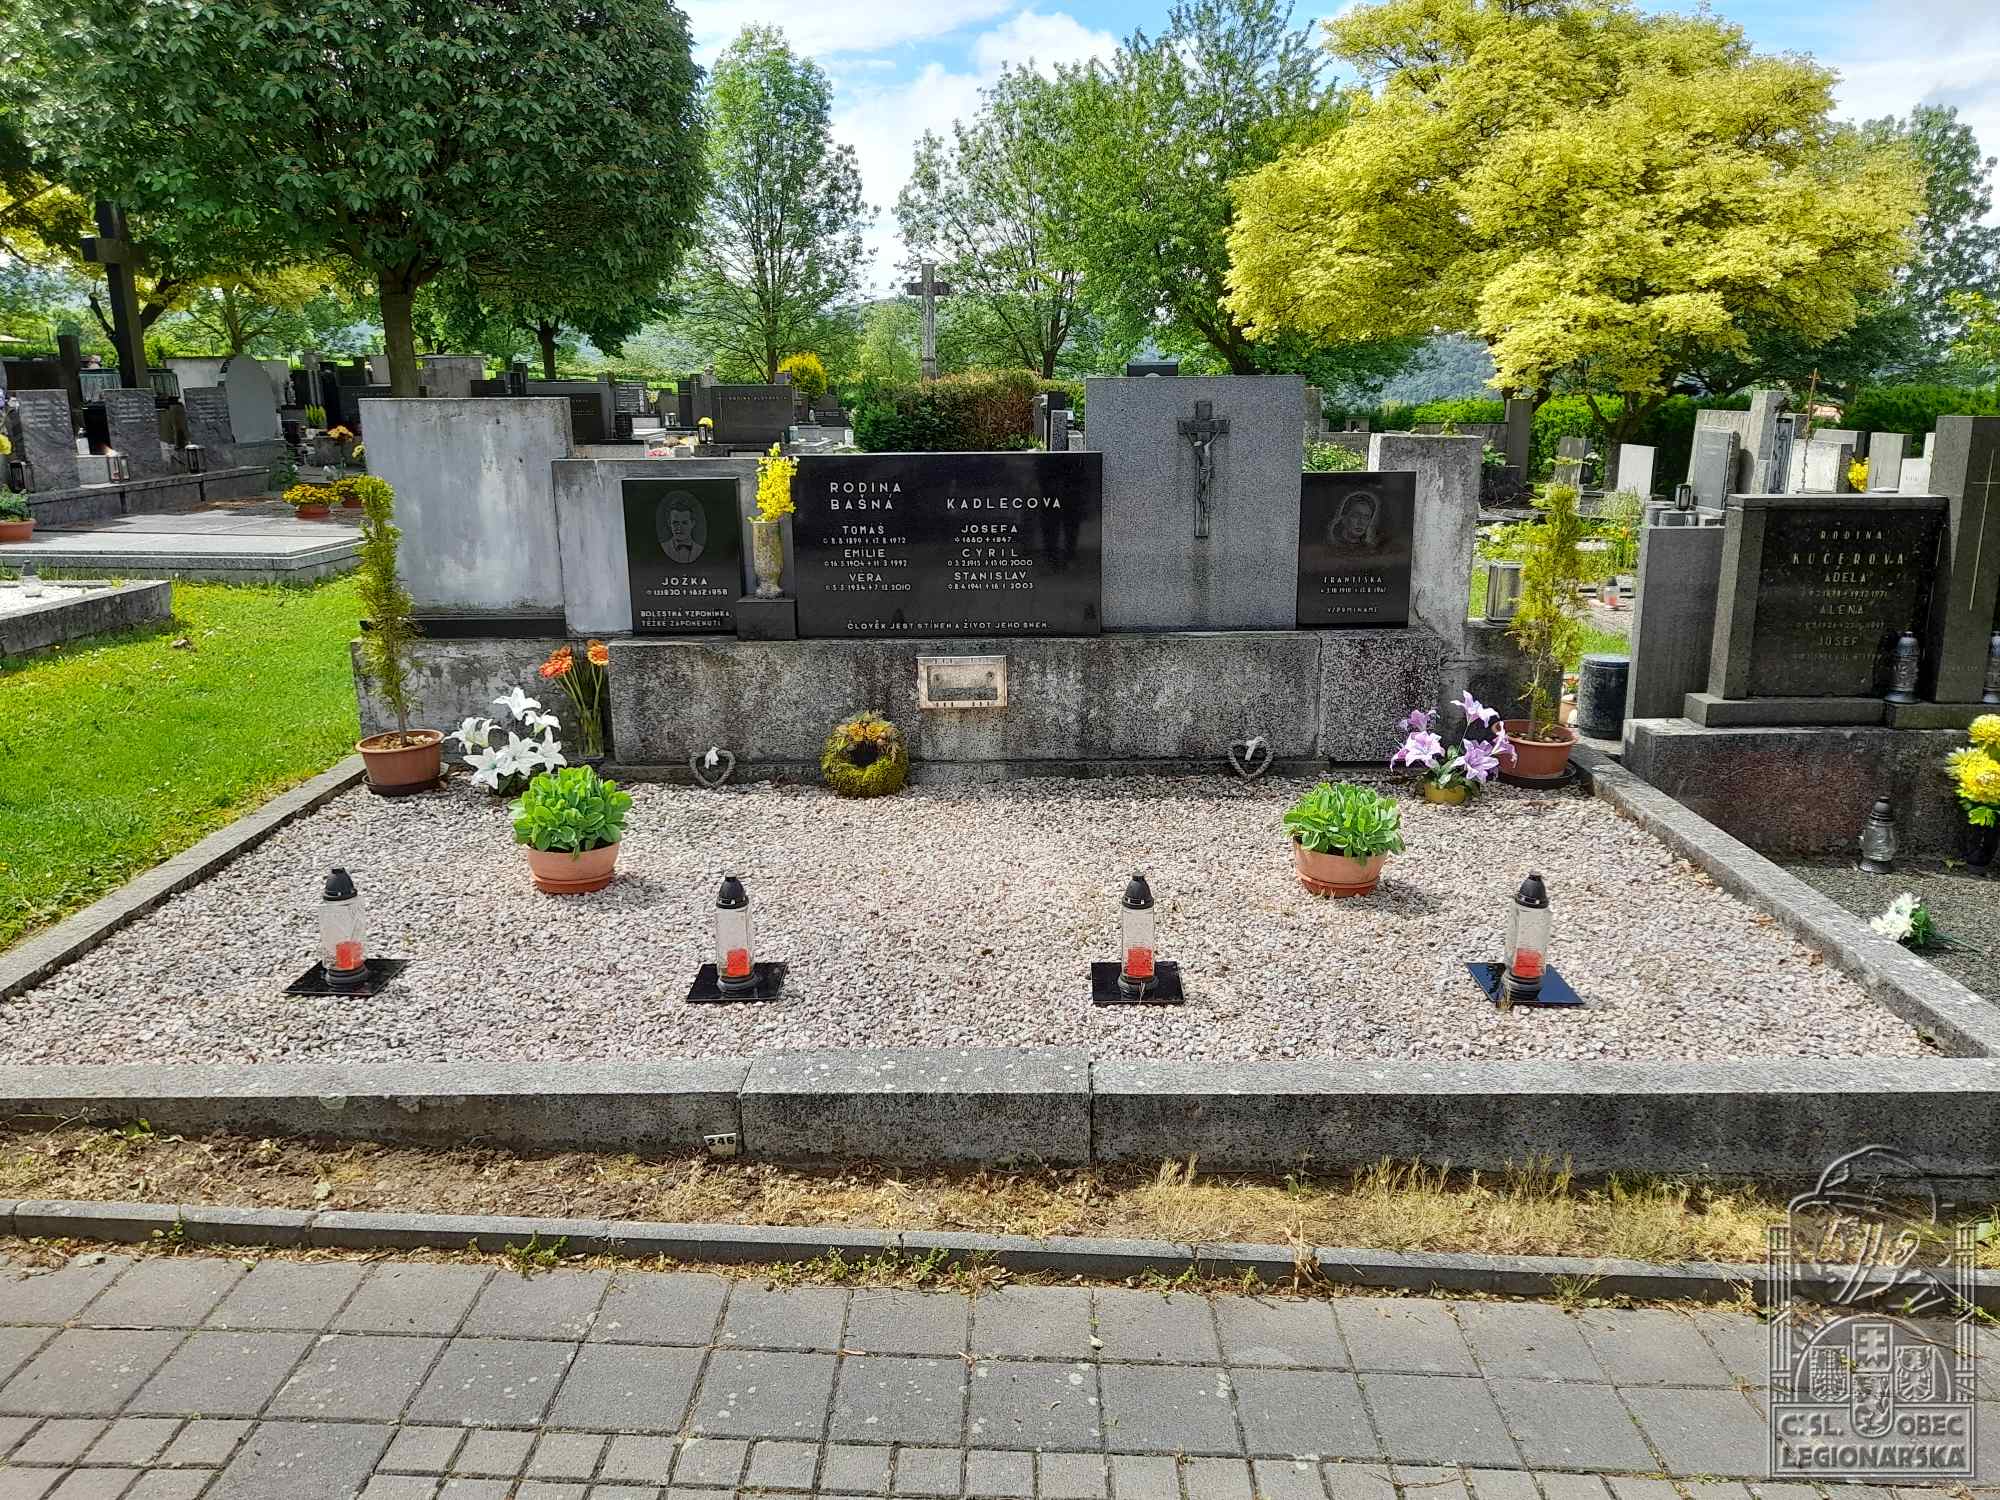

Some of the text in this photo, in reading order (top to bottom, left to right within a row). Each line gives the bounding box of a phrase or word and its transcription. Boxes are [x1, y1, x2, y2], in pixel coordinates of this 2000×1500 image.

[829, 482, 901, 493] RODINA
[830, 494, 893, 510] BAŠNÁ
[961, 524, 1018, 534] JOSEFA
[1820, 531, 1883, 540] RODINA
[961, 548, 1018, 558] CYRIL
[954, 571, 1026, 580] STANISLAV
[1819, 605, 1864, 615] ALENA
